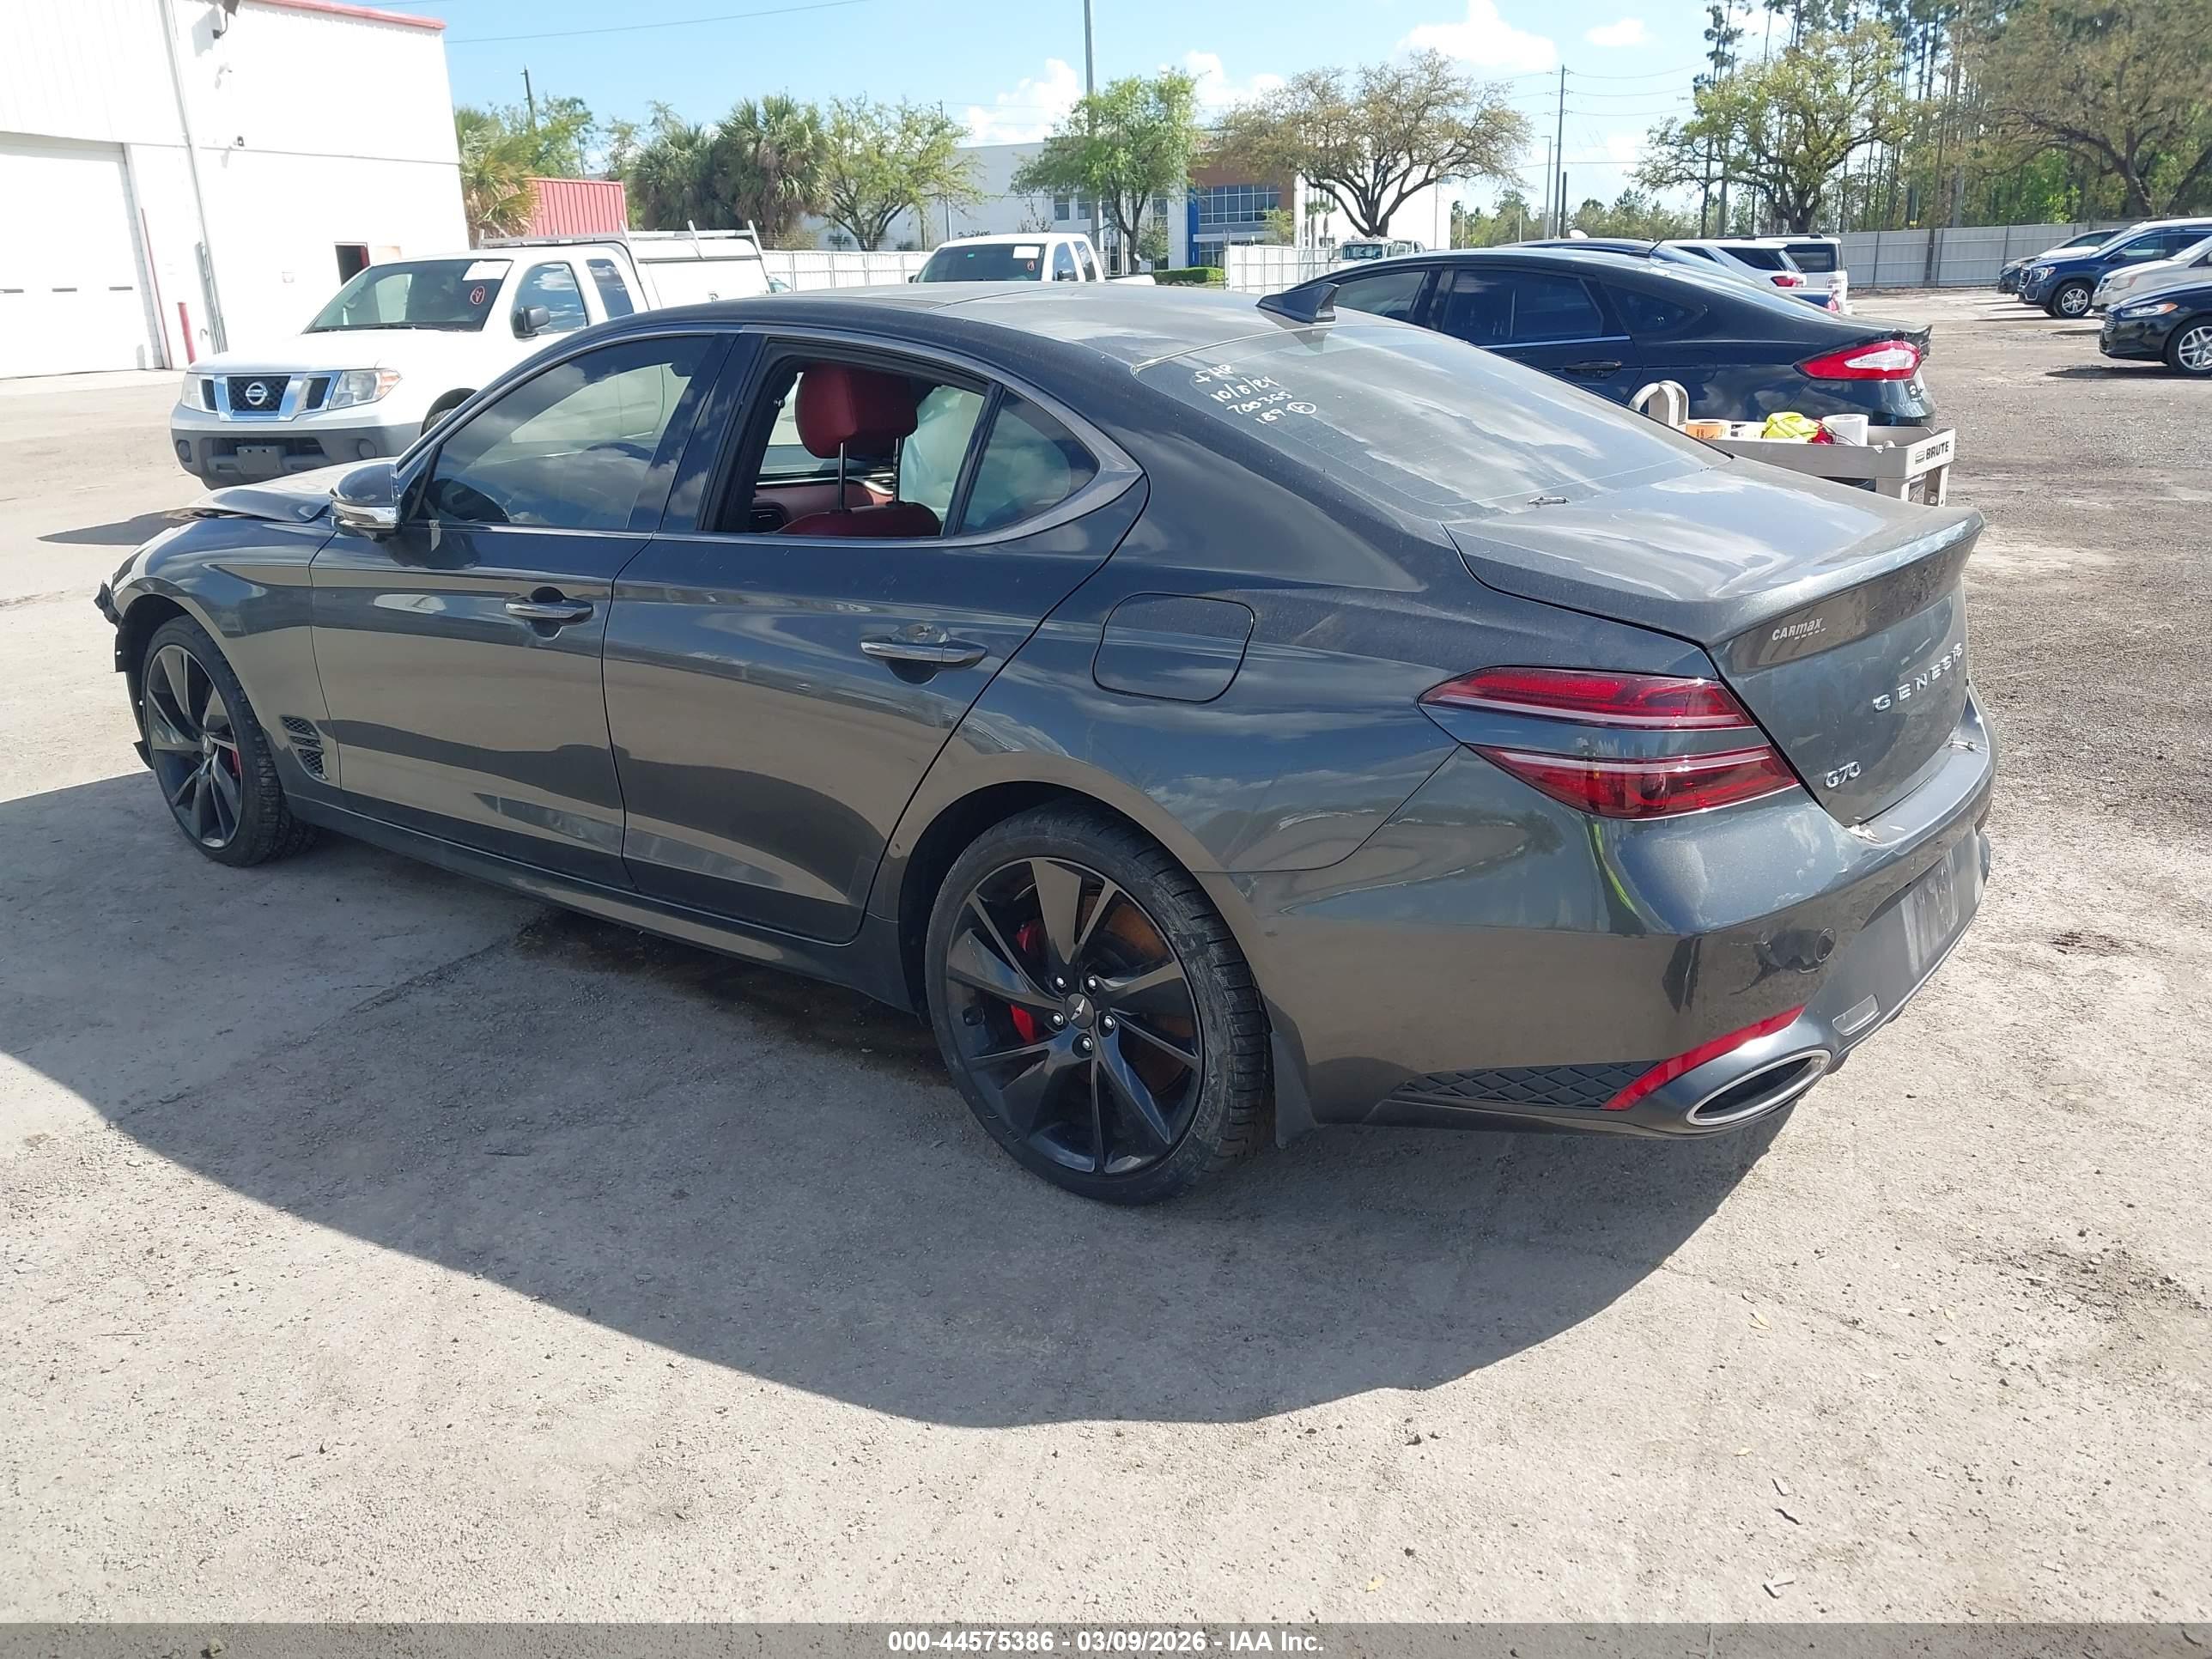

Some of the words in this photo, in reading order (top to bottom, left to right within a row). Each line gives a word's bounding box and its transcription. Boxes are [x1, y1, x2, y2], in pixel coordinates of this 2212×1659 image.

[1925, 441, 1950, 460] BRUTE
[1873, 642, 1963, 712] GENESIS
[1826, 761, 1862, 788] G70
